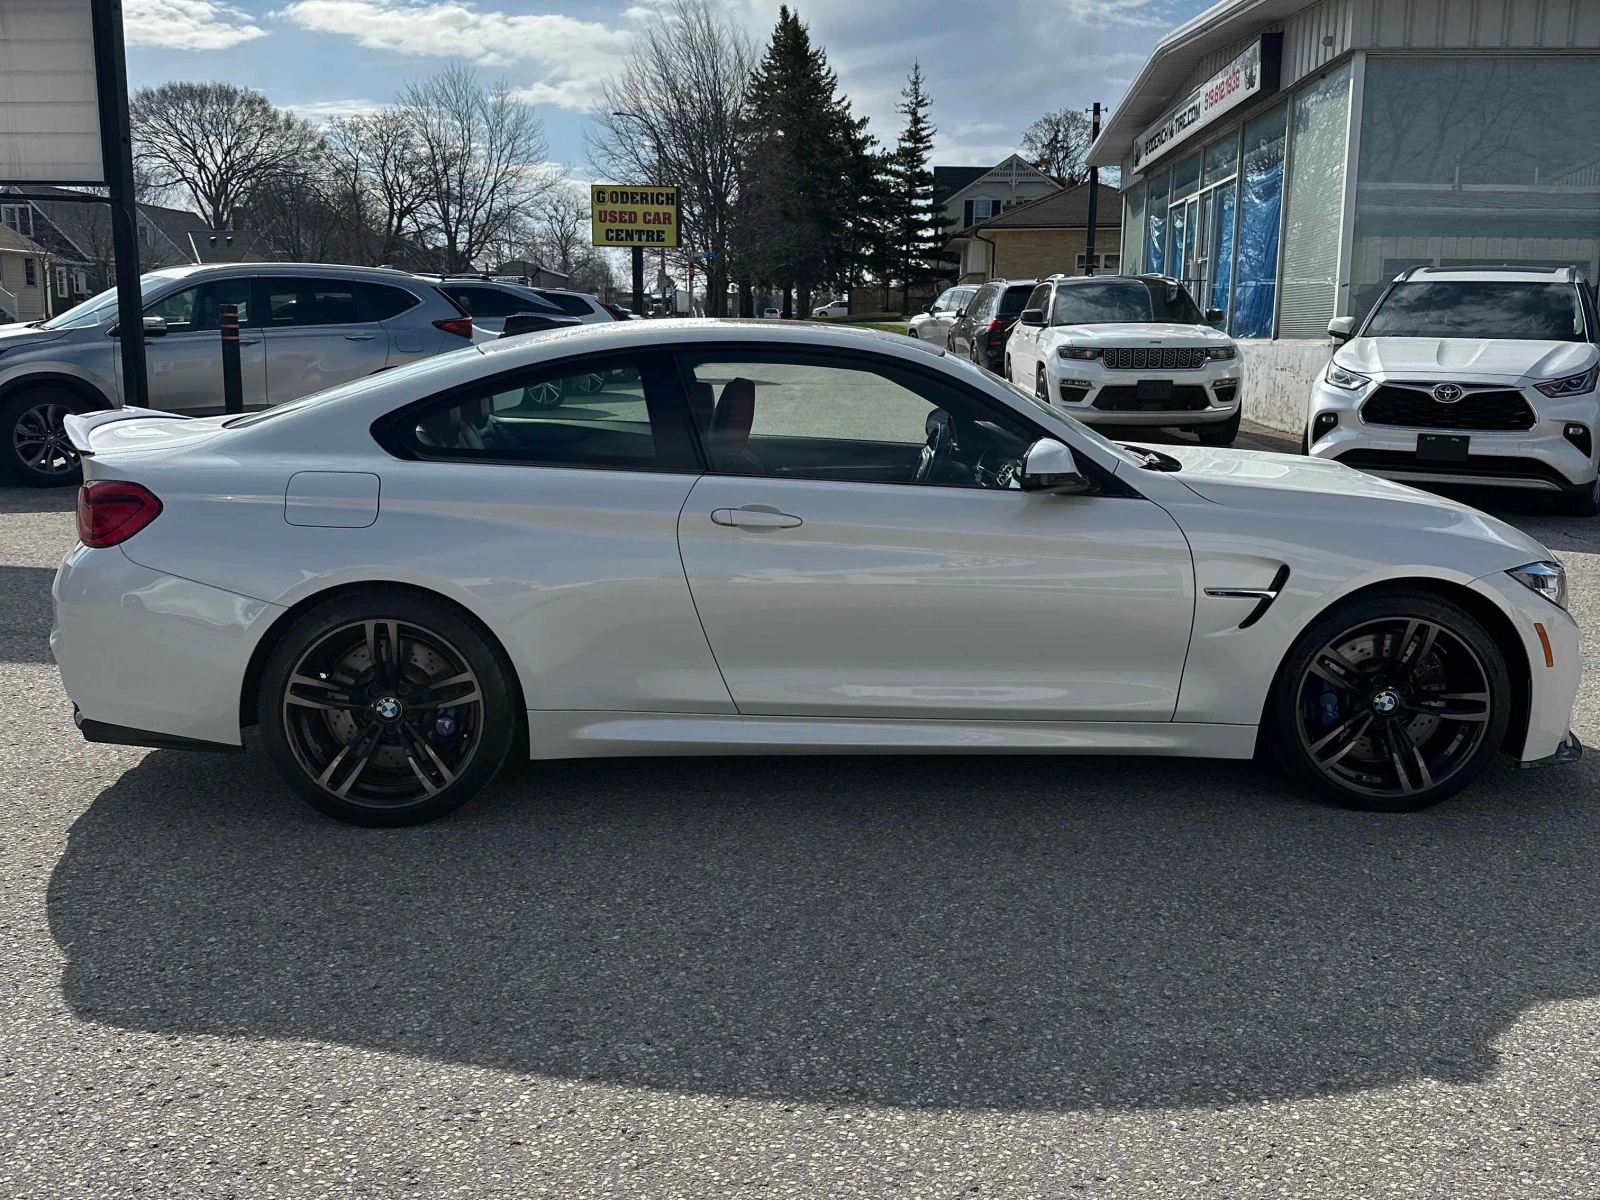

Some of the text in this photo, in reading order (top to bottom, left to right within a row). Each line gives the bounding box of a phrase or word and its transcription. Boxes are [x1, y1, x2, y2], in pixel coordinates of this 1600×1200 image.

[595, 190, 675, 206] GODERICH
[598, 210, 673, 225] USED CAR
[605, 228, 665, 242] CENTRE
